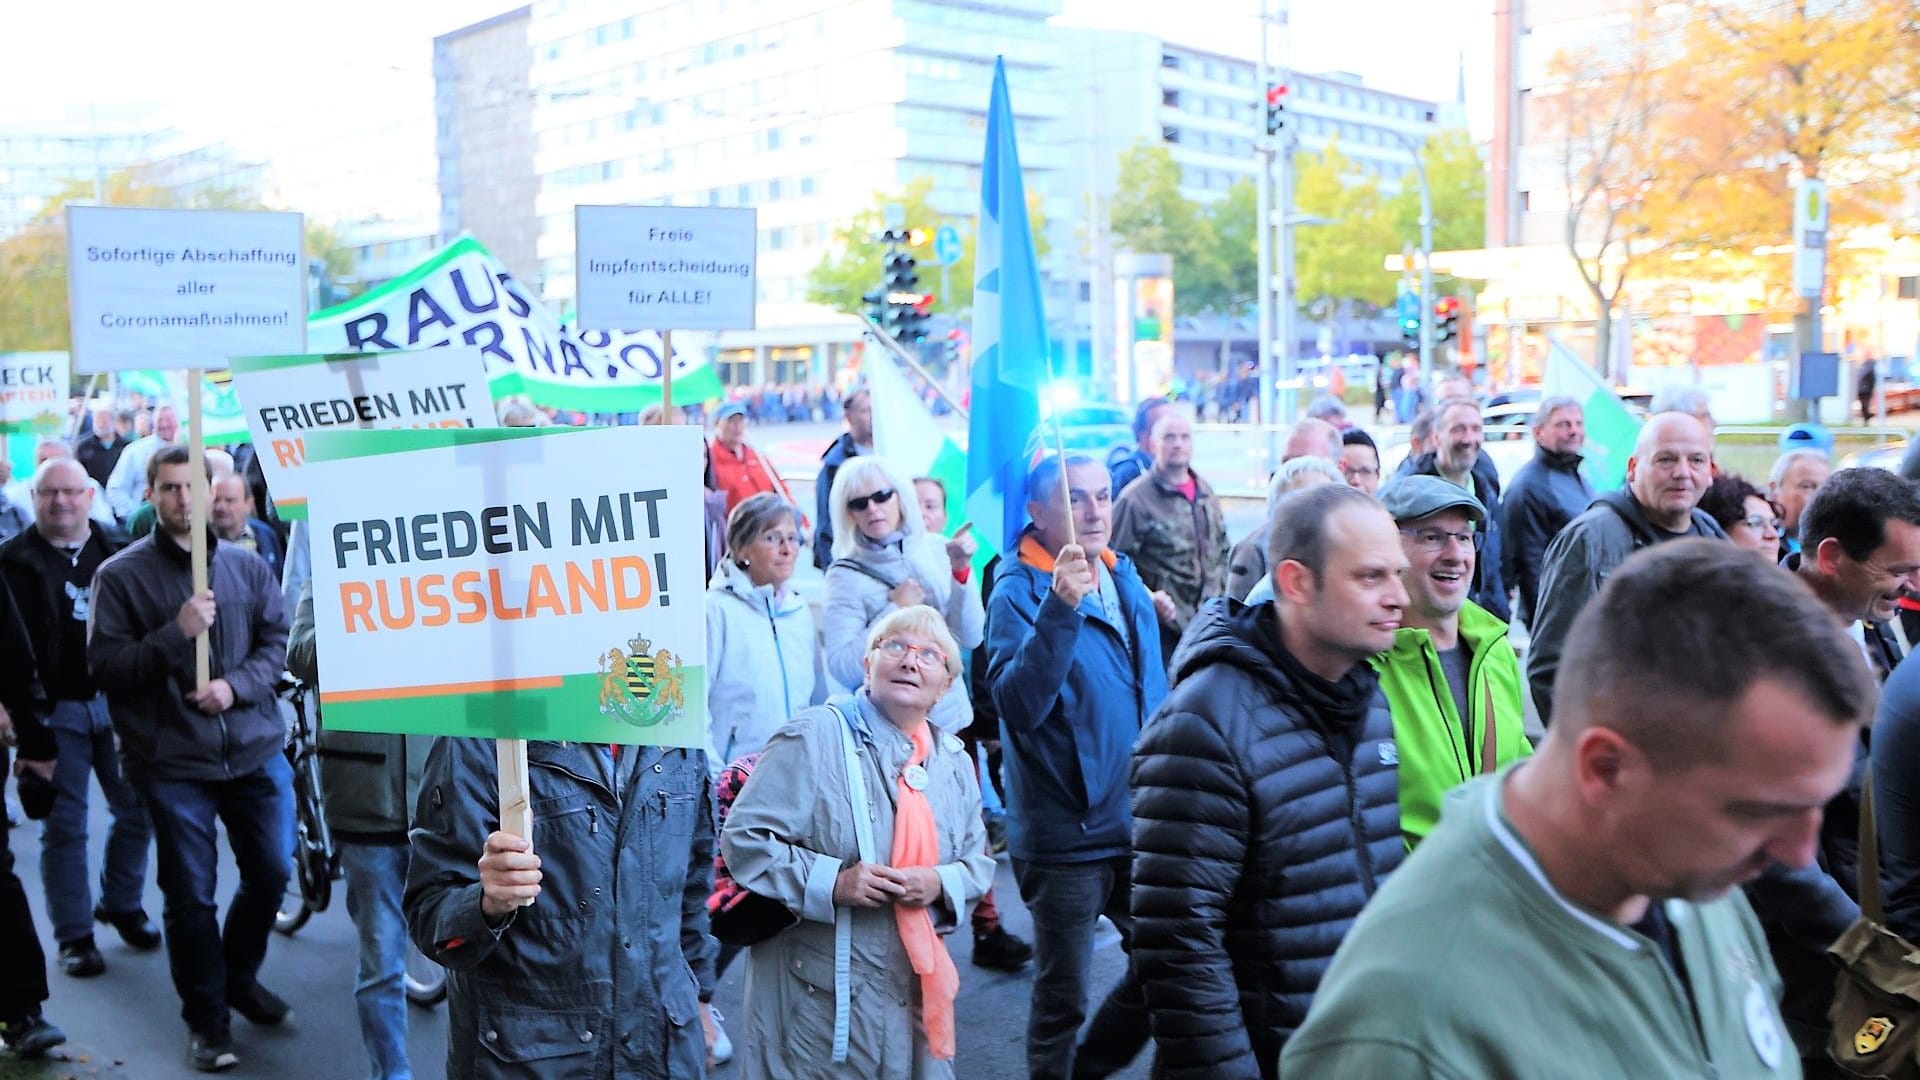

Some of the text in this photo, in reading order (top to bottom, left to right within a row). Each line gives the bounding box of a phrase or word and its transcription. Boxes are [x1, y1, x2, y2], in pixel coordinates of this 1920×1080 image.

[648, 227, 694, 242] Freie
[87, 246, 297, 266] Sofortige Abschaffung
[589, 259, 750, 278] Impfentscheidung
[176, 280, 216, 296] aller
[629, 289, 712, 305] für ALLE!
[344, 264, 531, 352] RAUS
[100, 311, 289, 329] Coronamaßnahmen!
[259, 383, 467, 433] FRIEDEN MIT
[333, 488, 668, 569] FRIEDEN MIT
[339, 552, 671, 634] RUSSLAND!
